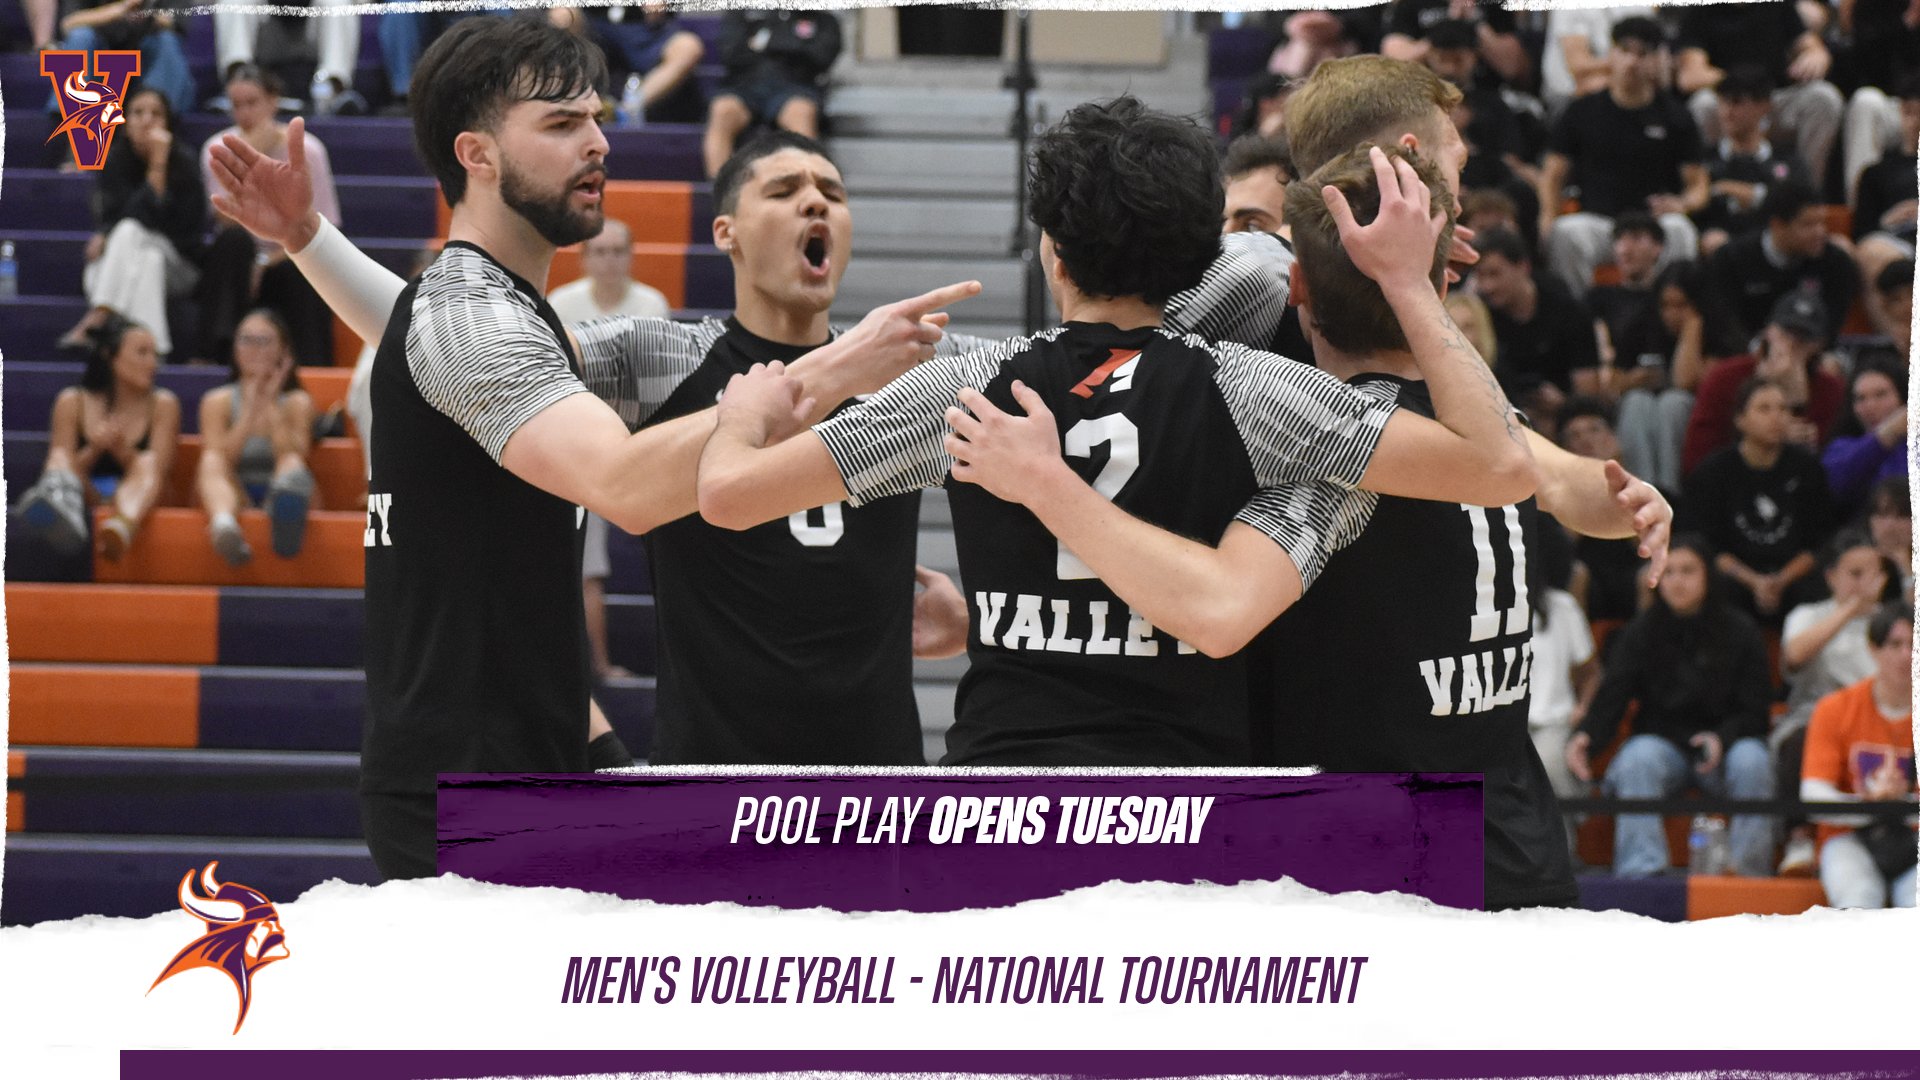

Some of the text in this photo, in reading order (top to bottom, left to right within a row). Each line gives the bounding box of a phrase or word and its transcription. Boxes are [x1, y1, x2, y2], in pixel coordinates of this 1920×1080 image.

[1459, 503, 1530, 643] 11
[975, 591, 1198, 657] VALLE
[1418, 636, 1534, 717] VALLE
